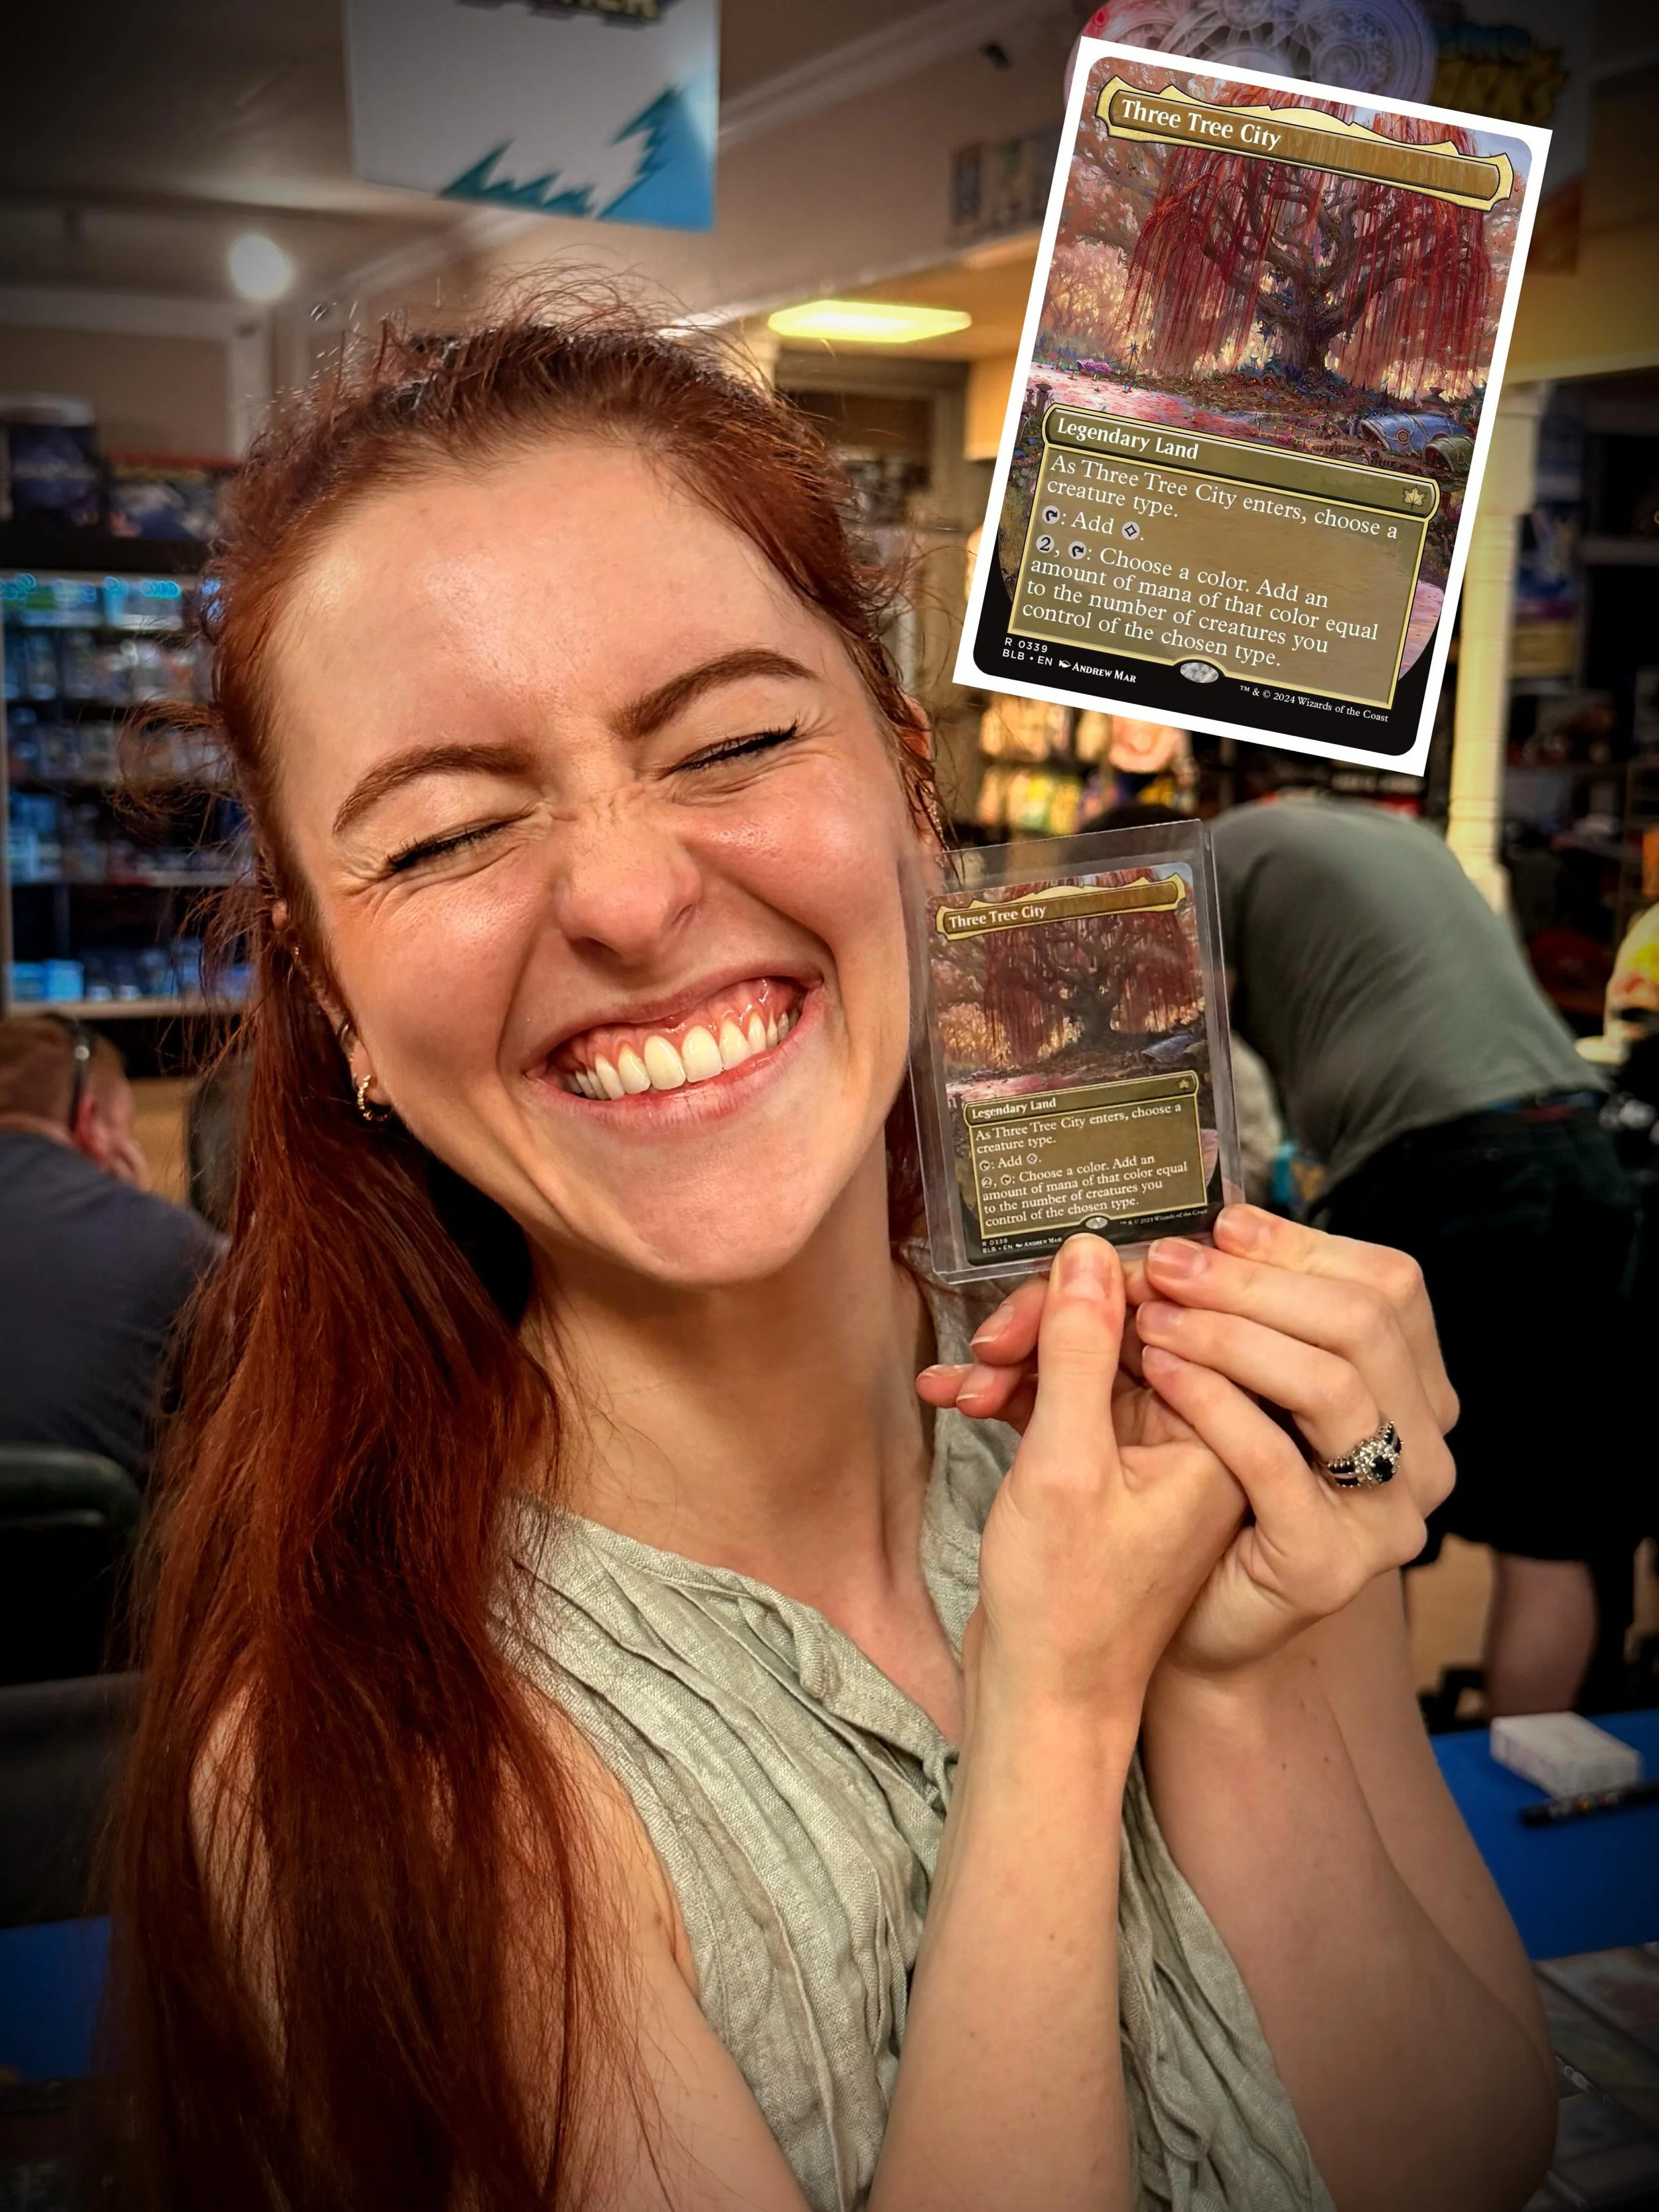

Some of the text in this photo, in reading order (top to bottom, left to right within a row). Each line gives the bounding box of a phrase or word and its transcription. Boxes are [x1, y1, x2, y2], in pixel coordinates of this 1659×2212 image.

[948, 905, 1046, 928] Three Tree City
[972, 1097, 1056, 1119] Legendary Land
[975, 1130, 991, 1140] As
[991, 1126, 1027, 1138] Three
[1029, 1121, 1056, 1132] Tree
[1060, 1116, 1085, 1128] City
[1089, 1112, 1129, 1124] enters,
[1131, 1106, 1171, 1118] choose
[977, 1136, 1056, 1153] creature type.
[997, 1155, 1022, 1168] Add
[1019, 1169, 1062, 1182] Choose
[1076, 1161, 1109, 1173] color.
[1112, 1155, 1137, 1169] Add
[1141, 1155, 1155, 1164] an
[983, 1161, 1187, 1201] amount of mana of that color equal
[999, 1201, 1017, 1211] the
[1021, 1194, 1067, 1208] number
[1070, 1189, 1083, 1201] of
[1086, 1185, 1137, 1199] creatures
[1141, 1181, 1162, 1193] you
[985, 1198, 1138, 1226] control of the chosen type.
